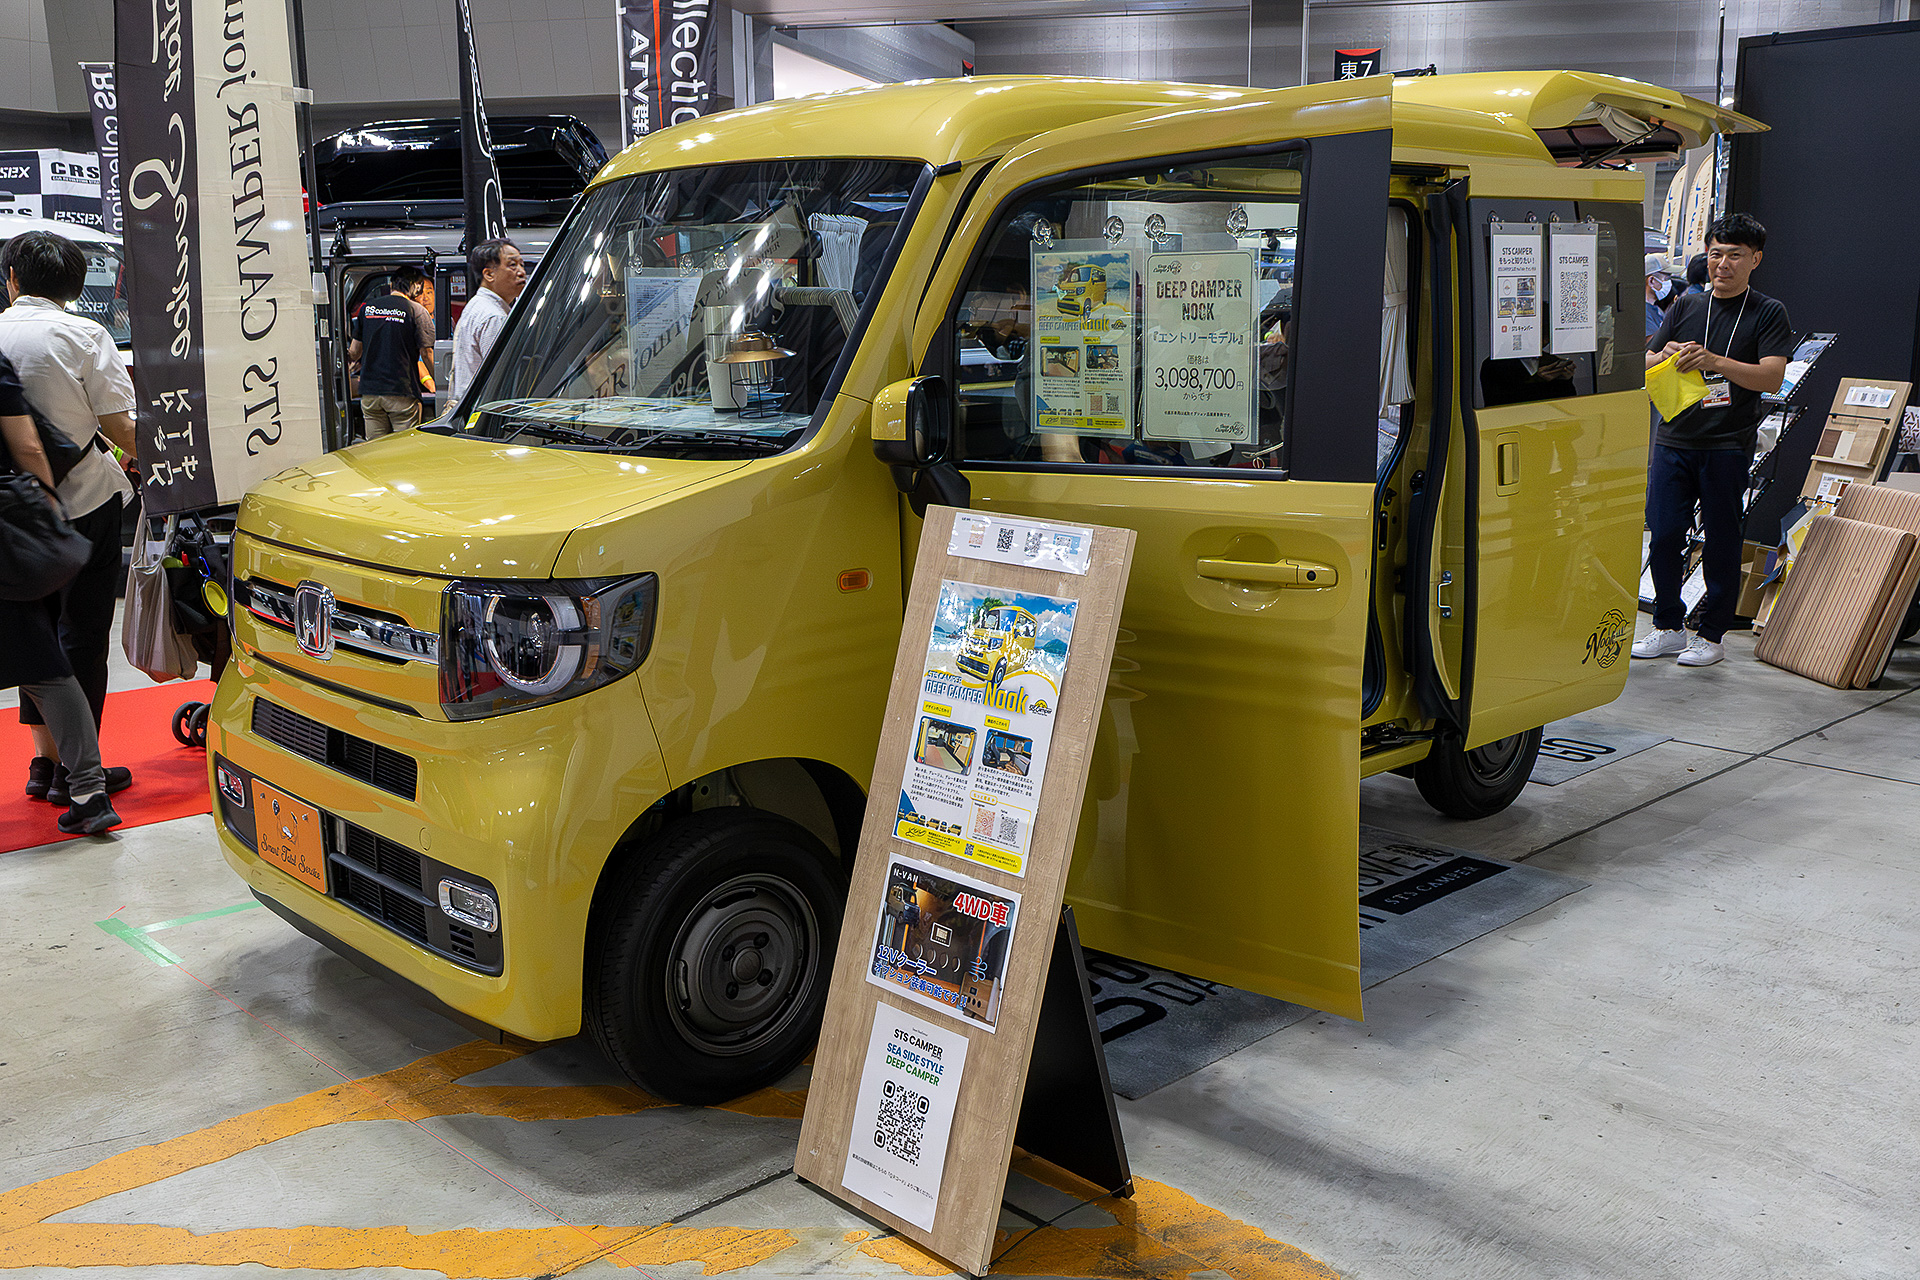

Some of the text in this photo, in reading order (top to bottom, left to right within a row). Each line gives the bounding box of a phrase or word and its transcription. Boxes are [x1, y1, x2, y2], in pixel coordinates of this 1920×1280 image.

[629, 28, 650, 142] ATV群
[50, 161, 100, 179] CRS
[1569, 256, 1589, 264] CAMPER
[1156, 279, 1243, 299] DEEP CAMPER
[1181, 303, 1215, 321] NOCK
[1186, 355, 1210, 365] 価格は
[1182, 392, 1213, 402] からです
[925, 679, 1029, 715] DEEP CAMPER Nook
[894, 868, 919, 883] N-VAN
[1416, 865, 1480, 892] CAMPER
[954, 891, 1009, 928] 4WD車
[877, 945, 938, 976] 12Vクーラー
[893, 1028, 909, 1043] STS
[909, 1035, 943, 1058] CAMPER
[885, 1054, 940, 1087] DEEP CAMPER
[886, 1042, 945, 1076] SEA SIDE STYLE
